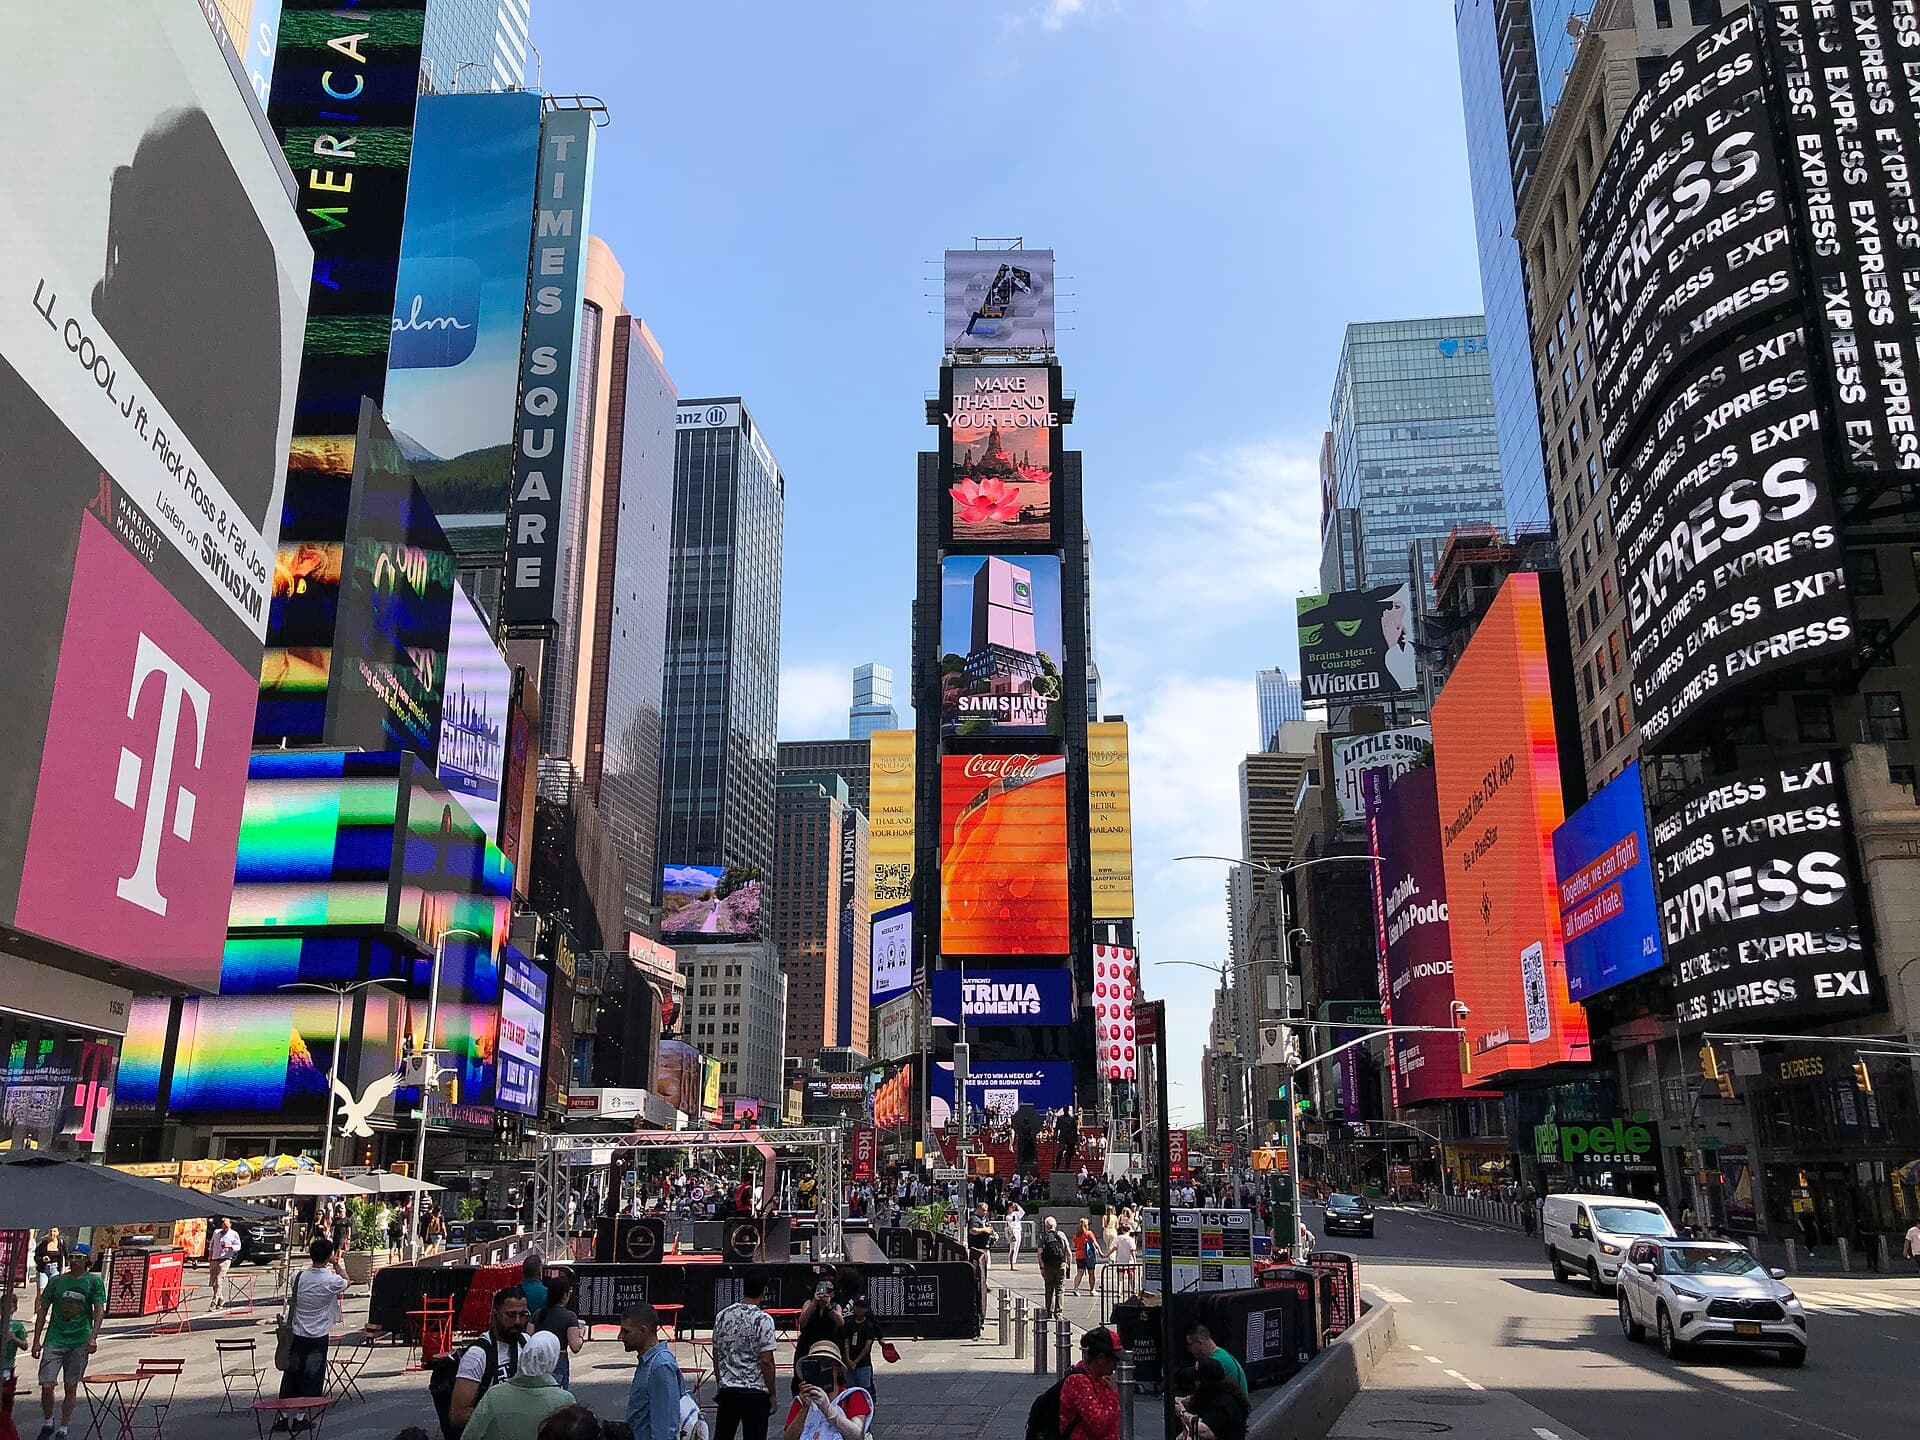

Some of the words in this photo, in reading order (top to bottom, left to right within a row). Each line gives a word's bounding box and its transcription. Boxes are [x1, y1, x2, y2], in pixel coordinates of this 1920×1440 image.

[1850, 0, 1895, 115] EXPRESS
[1628, 131, 1695, 216] EXPRESS
[1667, 190, 1776, 274] EXPRESS
[1796, 134, 1841, 257] EXPRESS
[1819, 271, 1867, 404] EXPRESS
[1824, 66, 1868, 185] EXPRESS
[1849, 200, 1896, 327] EXPRESS
[1873, 340, 1920, 470] EXPRESS
[1680, 270, 1790, 345] EXPRESS
[953, 395, 1045, 411] THAILAND
[974, 377, 1026, 393] MAKE
[944, 412, 998, 428] YOUR
[1001, 412, 1058, 428] HOME
[1693, 369, 1809, 443] EXPRESS
[64, 318, 118, 405] COOL
[121, 394, 136, 419] J
[134, 406, 149, 440] ft.
[151, 427, 183, 484] Rick
[184, 467, 216, 525] Ross
[216, 514, 227, 536] &
[227, 525, 247, 566] Fat
[245, 553, 267, 585] Joe
[115, 514, 156, 565] MARQUIS
[118, 496, 163, 551] MARRIOTT
[155, 489, 184, 540] Listen
[185, 530, 199, 552] on
[200, 533, 263, 624] SiriusXM
[1627, 456, 1818, 635] EXPRESS
[1659, 579, 1707, 640] EXPRESS
[1712, 524, 1835, 590] EXPRESS
[1308, 650, 1343, 663] Brains.
[1345, 648, 1376, 658] Heart.
[1321, 656, 1365, 669] Courage.
[1644, 646, 1685, 699] EXPRESS
[1671, 663, 1720, 718] EXPRESS
[1725, 616, 1851, 678] EXPRESS
[958, 696, 1048, 711] SAMSUNG
[1344, 735, 1391, 766] LITTLE
[1380, 753, 1390, 761] OF
[882, 806, 905, 814] MAKE
[1090, 790, 1109, 798] STAY
[1445, 797, 1473, 848] Download
[1472, 790, 1484, 815] the
[1483, 766, 1498, 801] TSX
[1499, 753, 1515, 786] App
[1684, 777, 1768, 825] EXPRESS
[871, 829, 893, 838] YOUR
[893, 828, 914, 838] HOME
[875, 817, 912, 826] THAILAND
[1666, 833, 1715, 879] EXPRESS
[1721, 802, 1842, 849] EXPRESS
[1562, 875, 1592, 905] Together,
[1591, 863, 1602, 888] we
[1602, 856, 1616, 878] can
[1616, 838, 1636, 871] fight
[1565, 915, 1573, 937] all
[1574, 906, 1594, 932] forms
[1594, 898, 1603, 921] of
[1602, 892, 1622, 917] hate.
[1663, 850, 1847, 946] EXPRESS
[1642, 935, 1658, 957] ADL
[961, 1001, 1041, 1014] MOMENTS
[962, 984, 1041, 1001] TRIVIA
[1711, 976, 1799, 1014] EXPRESS
[1353, 1007, 1373, 1017] Pick
[1780, 1056, 1824, 1081] EXPRESS
[858, 1131, 872, 1160] tkts
[1169, 1132, 1182, 1162] tkts
[1583, 1154, 1641, 1163] SOCCER
[1201, 1213, 1229, 1227] TSQ
